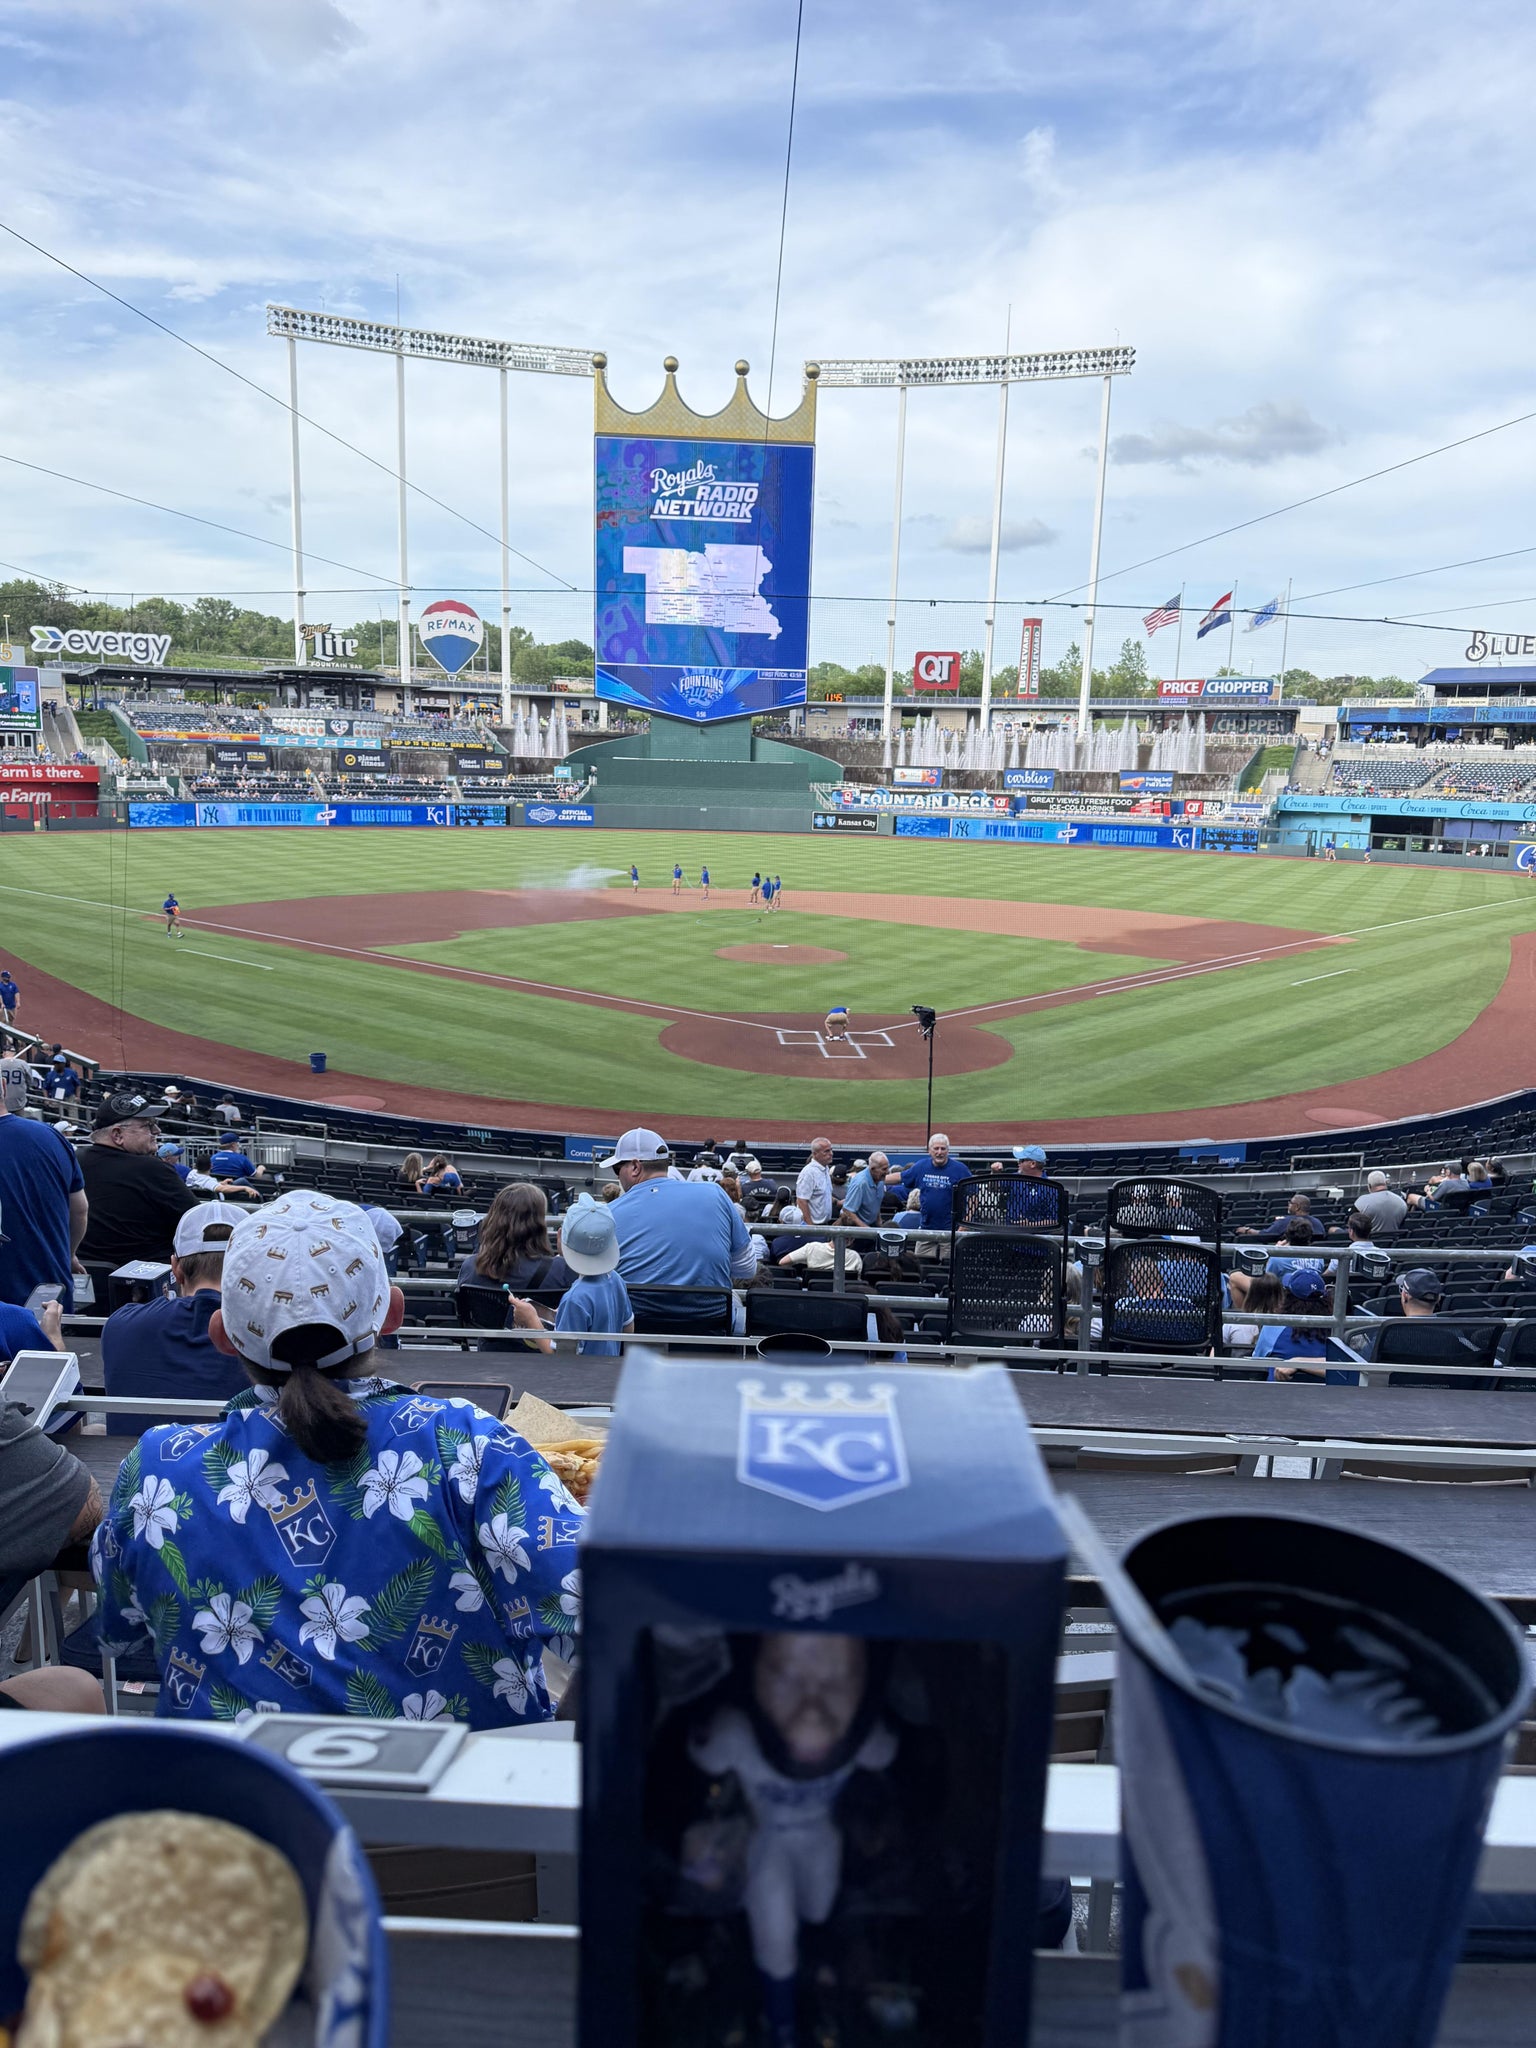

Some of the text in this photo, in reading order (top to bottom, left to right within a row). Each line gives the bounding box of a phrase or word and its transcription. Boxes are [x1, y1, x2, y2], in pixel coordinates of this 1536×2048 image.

[650, 460, 715, 496] Royals
[696, 485, 759, 502] RADIO
[653, 499, 755, 518] NETWORK
[300, 624, 332, 639] Miller
[427, 619, 475, 634] RE/MAX
[67, 631, 169, 663] evergy
[312, 632, 359, 662] Lite
[919, 655, 954, 683] QT
[680, 675, 723, 694] FOUNTAINS
[1162, 681, 1269, 694] PRICE CHOPPER
[32, 767, 42, 778] is
[46, 767, 84, 778] there.
[1006, 770, 1051, 784] carbliss
[861, 793, 942, 809] FOUNTAIN
[949, 795, 990, 808] DECK
[1186, 802, 1200, 813] QT
[1283, 796, 1309, 809] Circa
[1341, 799, 1367, 811] Circa
[1400, 801, 1425, 813] Circa
[1460, 803, 1487, 816] Circa
[238, 809, 302, 822] NEW YORK YANKEES
[351, 809, 413, 822] KANSAS CITY ROYALS
[426, 807, 444, 825] KC
[838, 818, 877, 828] Kansas City
[986, 824, 1043, 839] NEW YORK YANKEES
[1092, 829, 1158, 844] KANSAS CITY ROYALS
[1171, 828, 1190, 848] KC
[397, 1405, 427, 1429] KC
[168, 1429, 194, 1457] KC
[755, 1417, 890, 1483] KC
[282, 1512, 330, 1554] KC
[556, 1521, 583, 1544] KC
[769, 1561, 881, 1622] Royals
[410, 1636, 443, 1668] KC
[278, 1658, 309, 1682] KC
[168, 1667, 196, 1705] KC
[286, 1726, 389, 1768] 6
